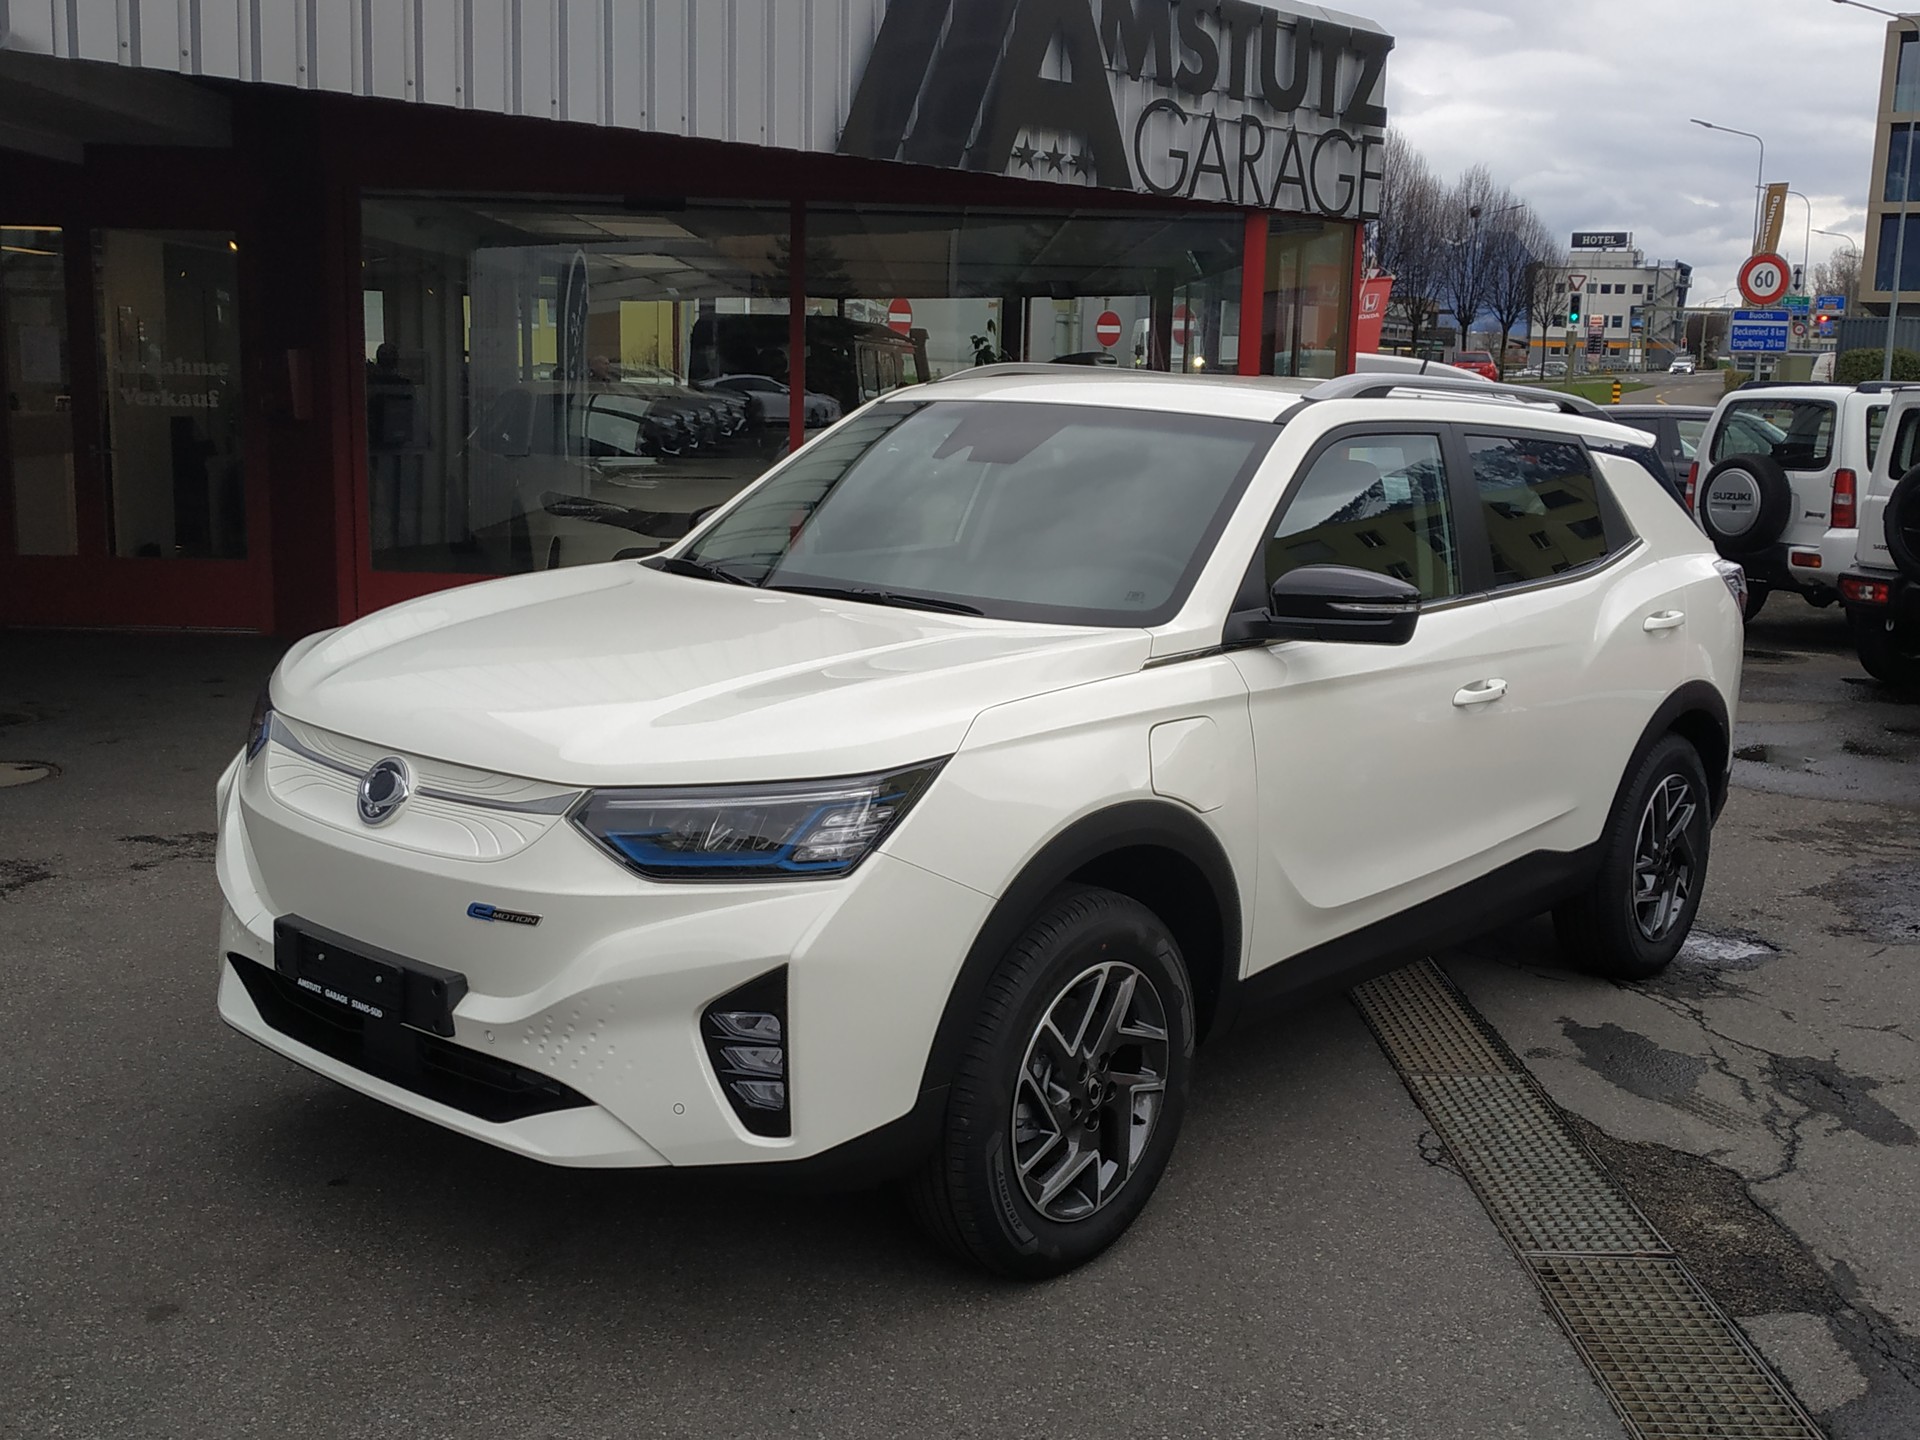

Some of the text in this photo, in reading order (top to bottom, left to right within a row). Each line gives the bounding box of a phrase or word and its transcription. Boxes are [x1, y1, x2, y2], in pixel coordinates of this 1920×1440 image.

[1134, 98, 1385, 221] GARAGE
[1582, 235, 1617, 245] HOTEL
[1754, 270, 1775, 289] 60
[1749, 312, 1774, 320] Buochs
[1732, 338, 1765, 350] Engelberg
[118, 387, 220, 408] Verkauf
[1712, 491, 1752, 501] SUZUKI
[297, 977, 322, 993] AMSTUTZ
[325, 989, 348, 1005] GARAGE
